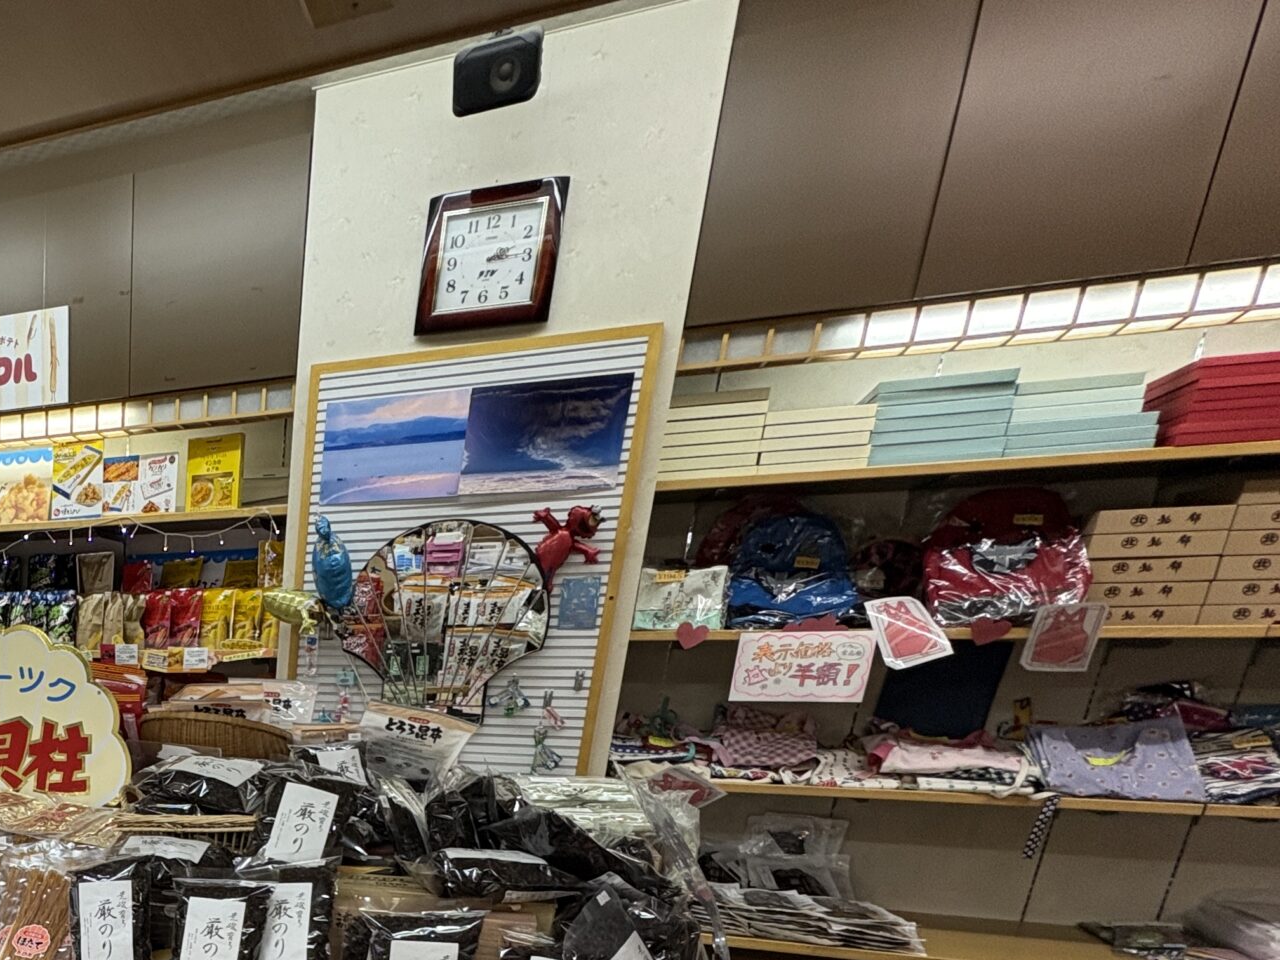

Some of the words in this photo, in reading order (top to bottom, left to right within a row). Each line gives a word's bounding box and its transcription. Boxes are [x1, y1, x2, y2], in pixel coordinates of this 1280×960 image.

[468, 220, 479, 234] 11
[486, 214, 501, 230] 12
[511, 214, 517, 229] 1
[523, 225, 533, 239] 2
[450, 234, 465, 249] 10
[521, 248, 532, 262] 3
[447, 258, 457, 272] 9
[515, 271, 524, 285] 4
[446, 279, 456, 293] 8
[499, 286, 510, 300] 5
[460, 290, 469, 304] 7
[477, 290, 488, 304] 6
[751, 641, 837, 663] 表示価格
[385, 716, 444, 744] とろろ昆布
[292, 802, 320, 855] 厳のり
[93, 901, 118, 960] 厳のり
[270, 898, 294, 960] 厳のり
[16, 936, 44, 951] ほたて
